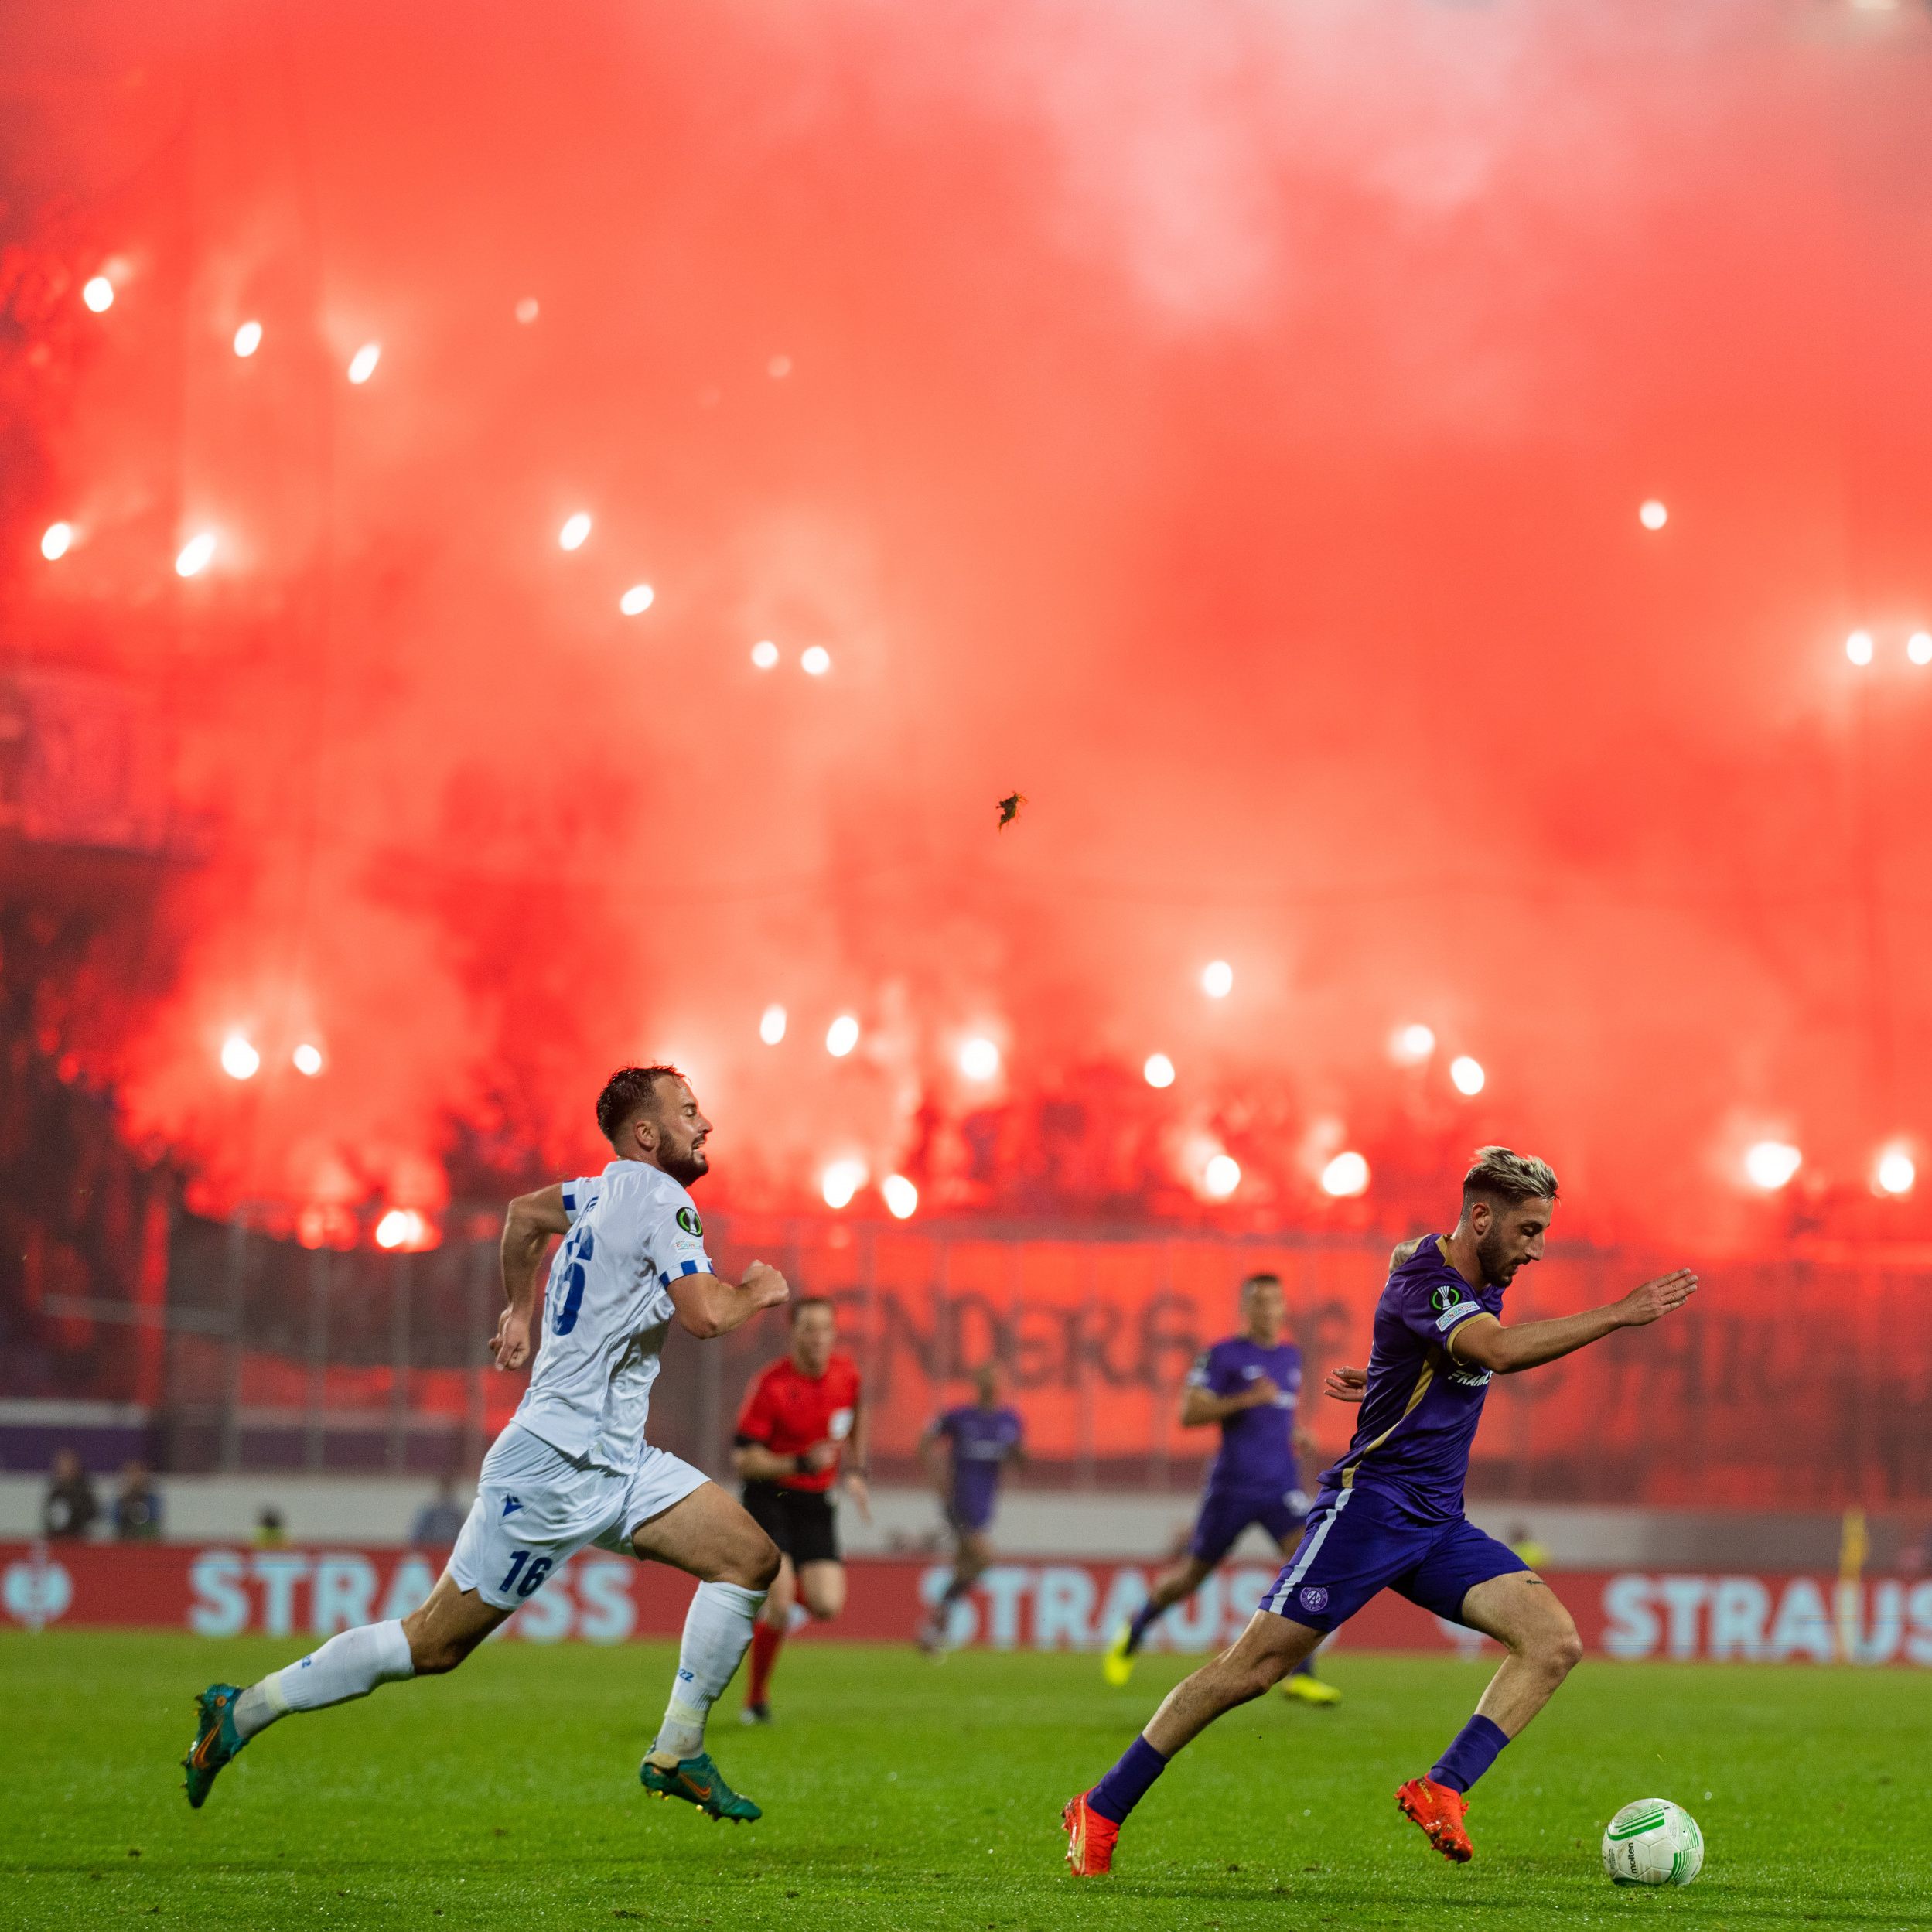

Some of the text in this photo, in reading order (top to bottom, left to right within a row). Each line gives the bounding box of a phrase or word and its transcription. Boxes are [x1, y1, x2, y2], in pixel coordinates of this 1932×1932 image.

[189, 1549, 640, 1645] STRASS
[499, 1550, 553, 1597] 16
[1627, 1842, 1637, 1874] molten
